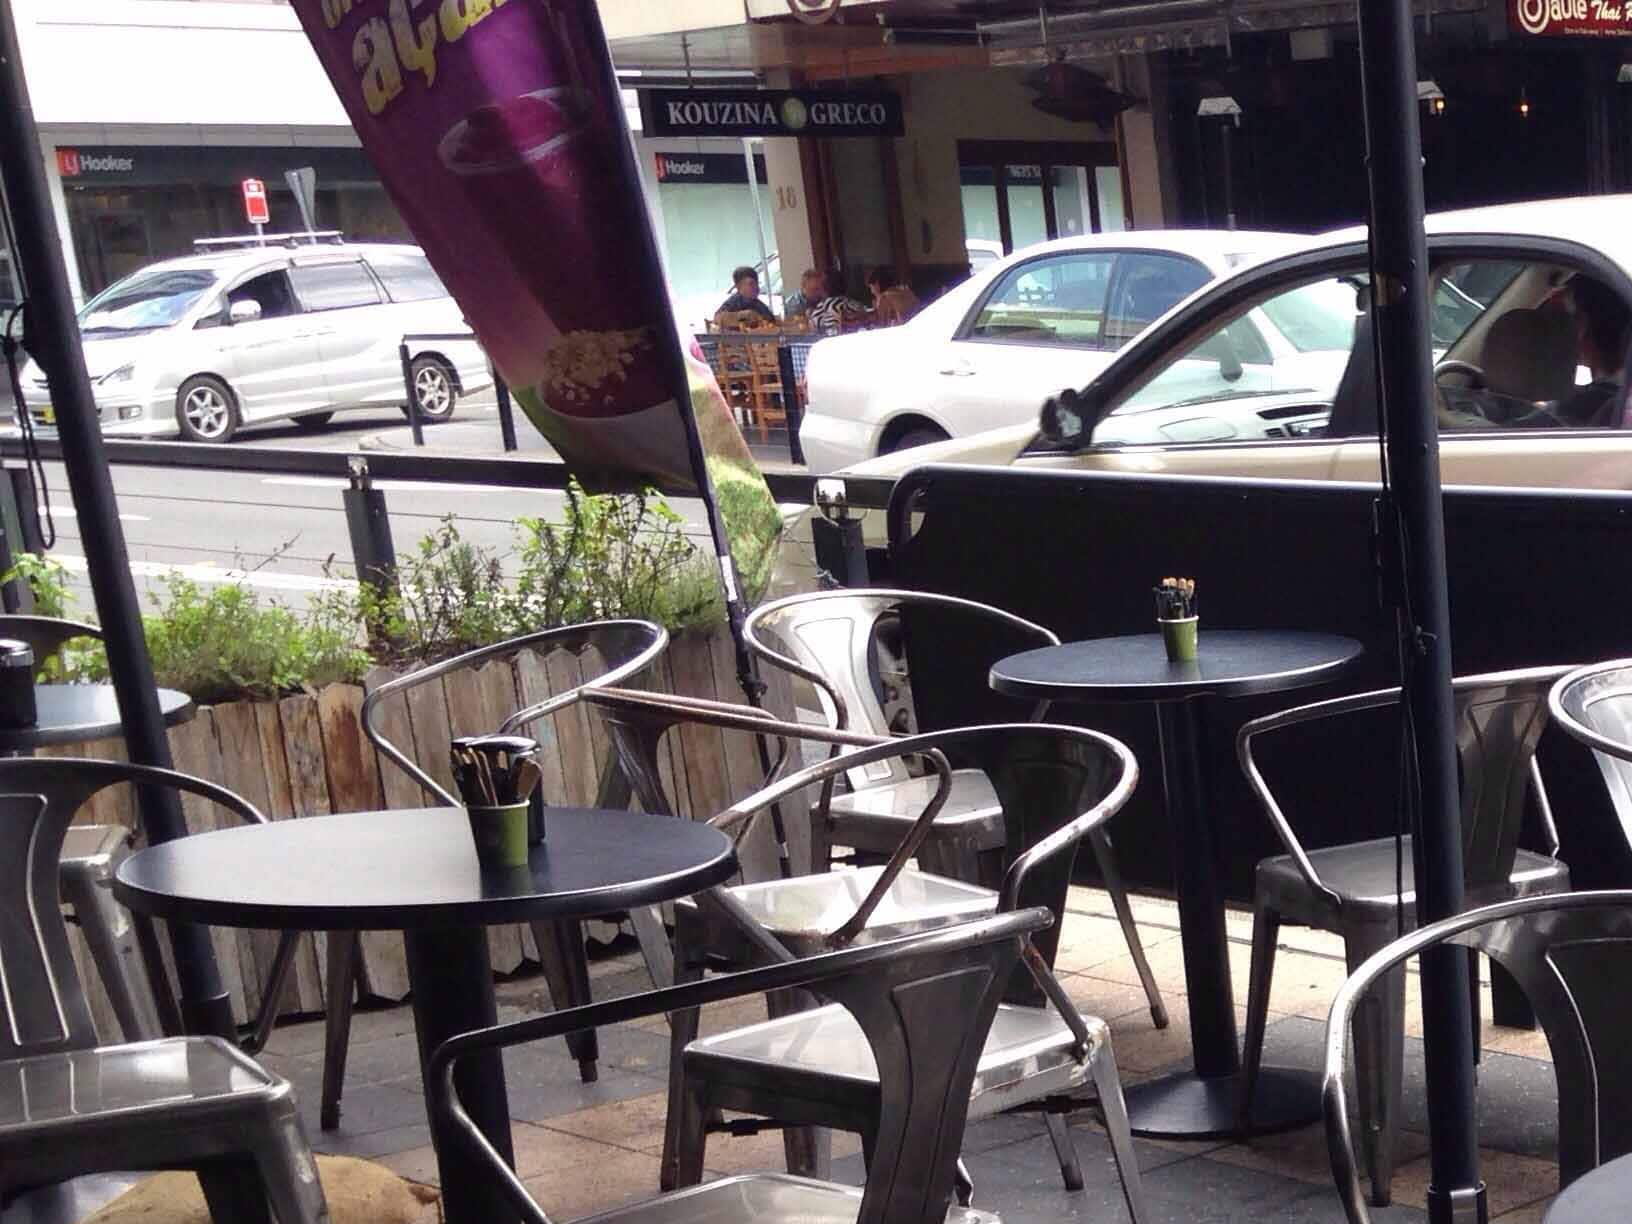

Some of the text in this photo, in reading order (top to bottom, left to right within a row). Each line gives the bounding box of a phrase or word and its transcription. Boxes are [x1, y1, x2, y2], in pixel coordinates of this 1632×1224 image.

[1591, 0, 1621, 20] Thai
[668, 101, 886, 125] KOUZINA GRECO
[80, 154, 133, 172] Hooker
